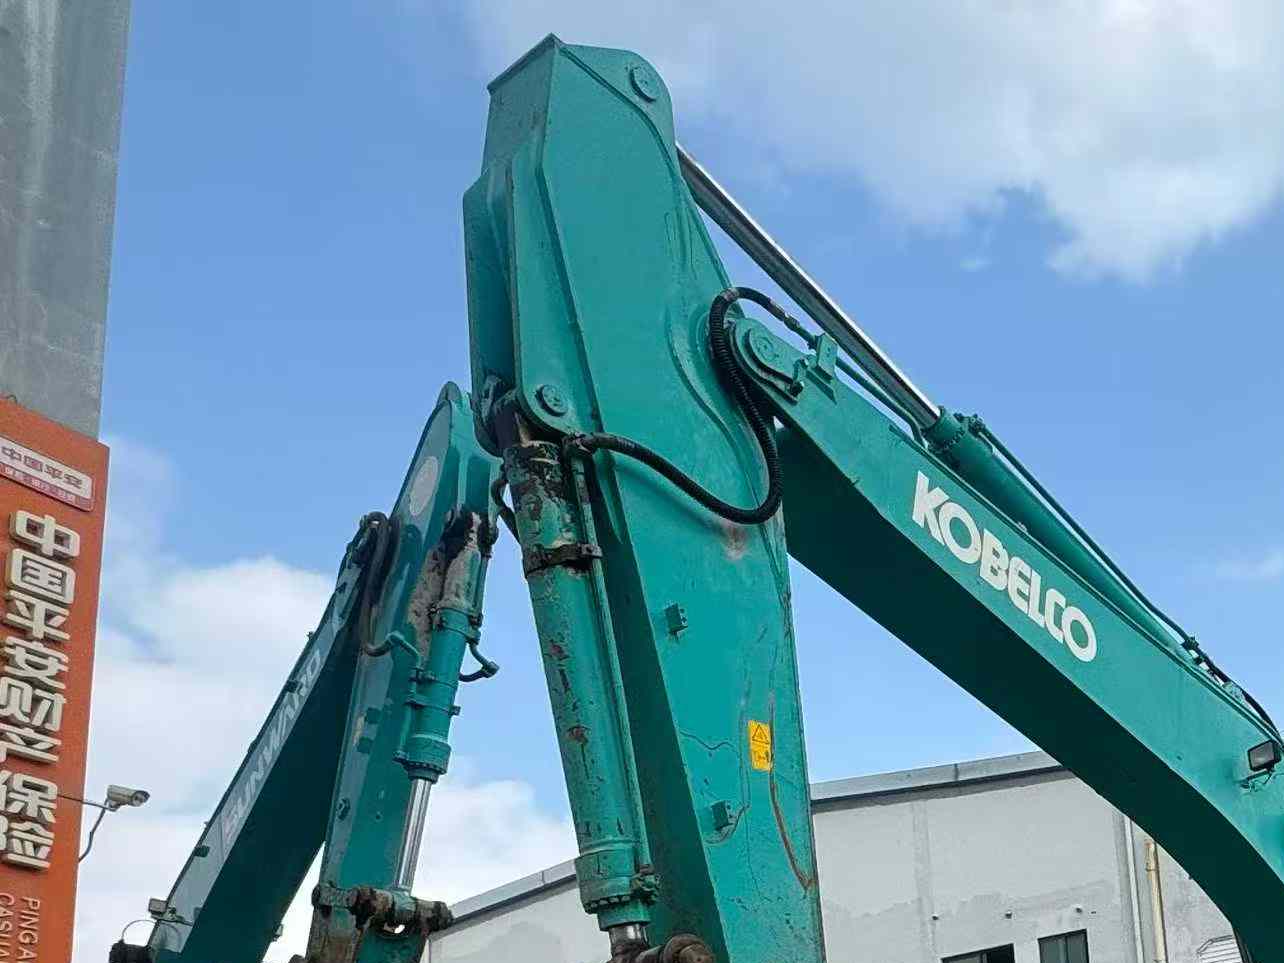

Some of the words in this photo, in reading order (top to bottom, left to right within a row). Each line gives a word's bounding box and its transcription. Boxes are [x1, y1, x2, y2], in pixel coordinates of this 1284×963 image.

[1, 446, 83, 490] 中国平安
[912, 470, 1098, 663] KOBELCO
[0, 510, 81, 870] 中国平安财产保险
[19, 896, 41, 946] PING
